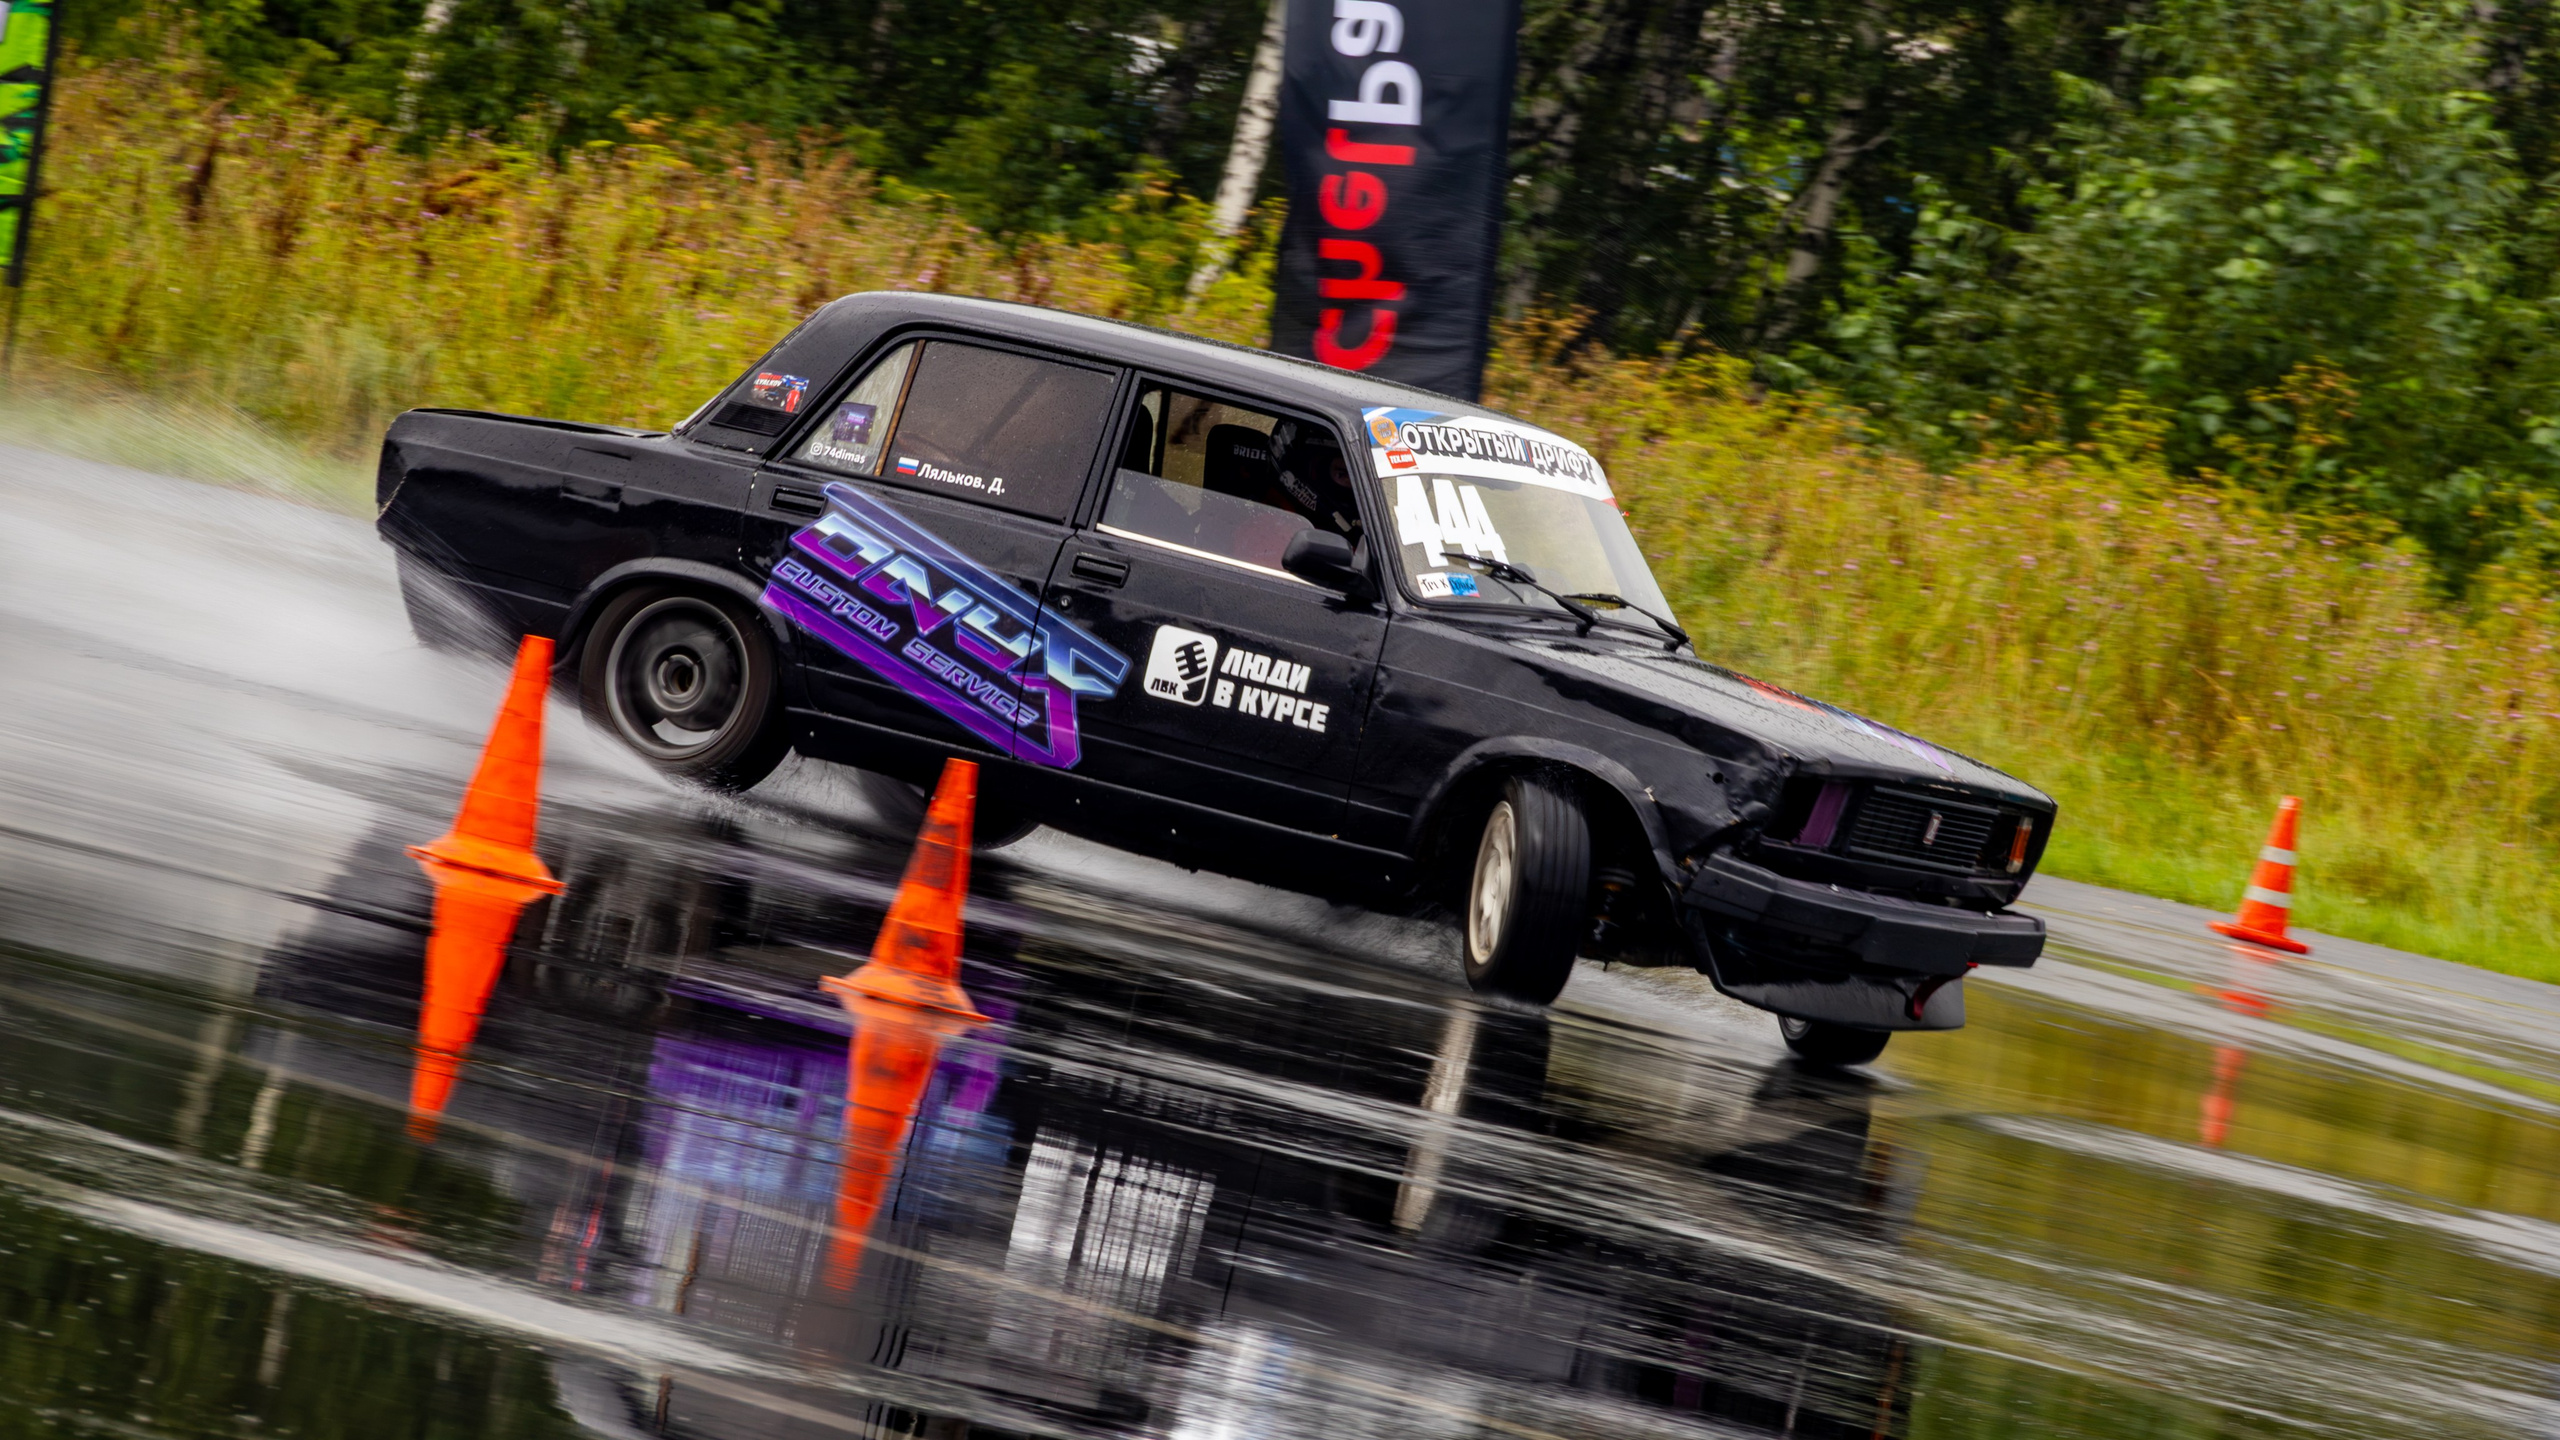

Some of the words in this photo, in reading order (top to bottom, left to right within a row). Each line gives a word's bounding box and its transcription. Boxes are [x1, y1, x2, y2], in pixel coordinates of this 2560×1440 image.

[823, 445, 866, 464] 74dimas
[1401, 422, 1528, 466] ОТКРЫТЫЙ
[1530, 440, 1596, 483] ДРИФТ
[917, 463, 986, 490] Ляльков.
[987, 477, 1005, 495] Д.
[1394, 475, 1511, 570] 444
[772, 556, 900, 643] CUSTOM
[902, 637, 1040, 727] SERVICE
[1150, 677, 1179, 696] ЛВК
[1220, 647, 1312, 694] ЛЮДИ
[1212, 678, 1236, 709] В
[1238, 685, 1331, 734] КУРСЕ
